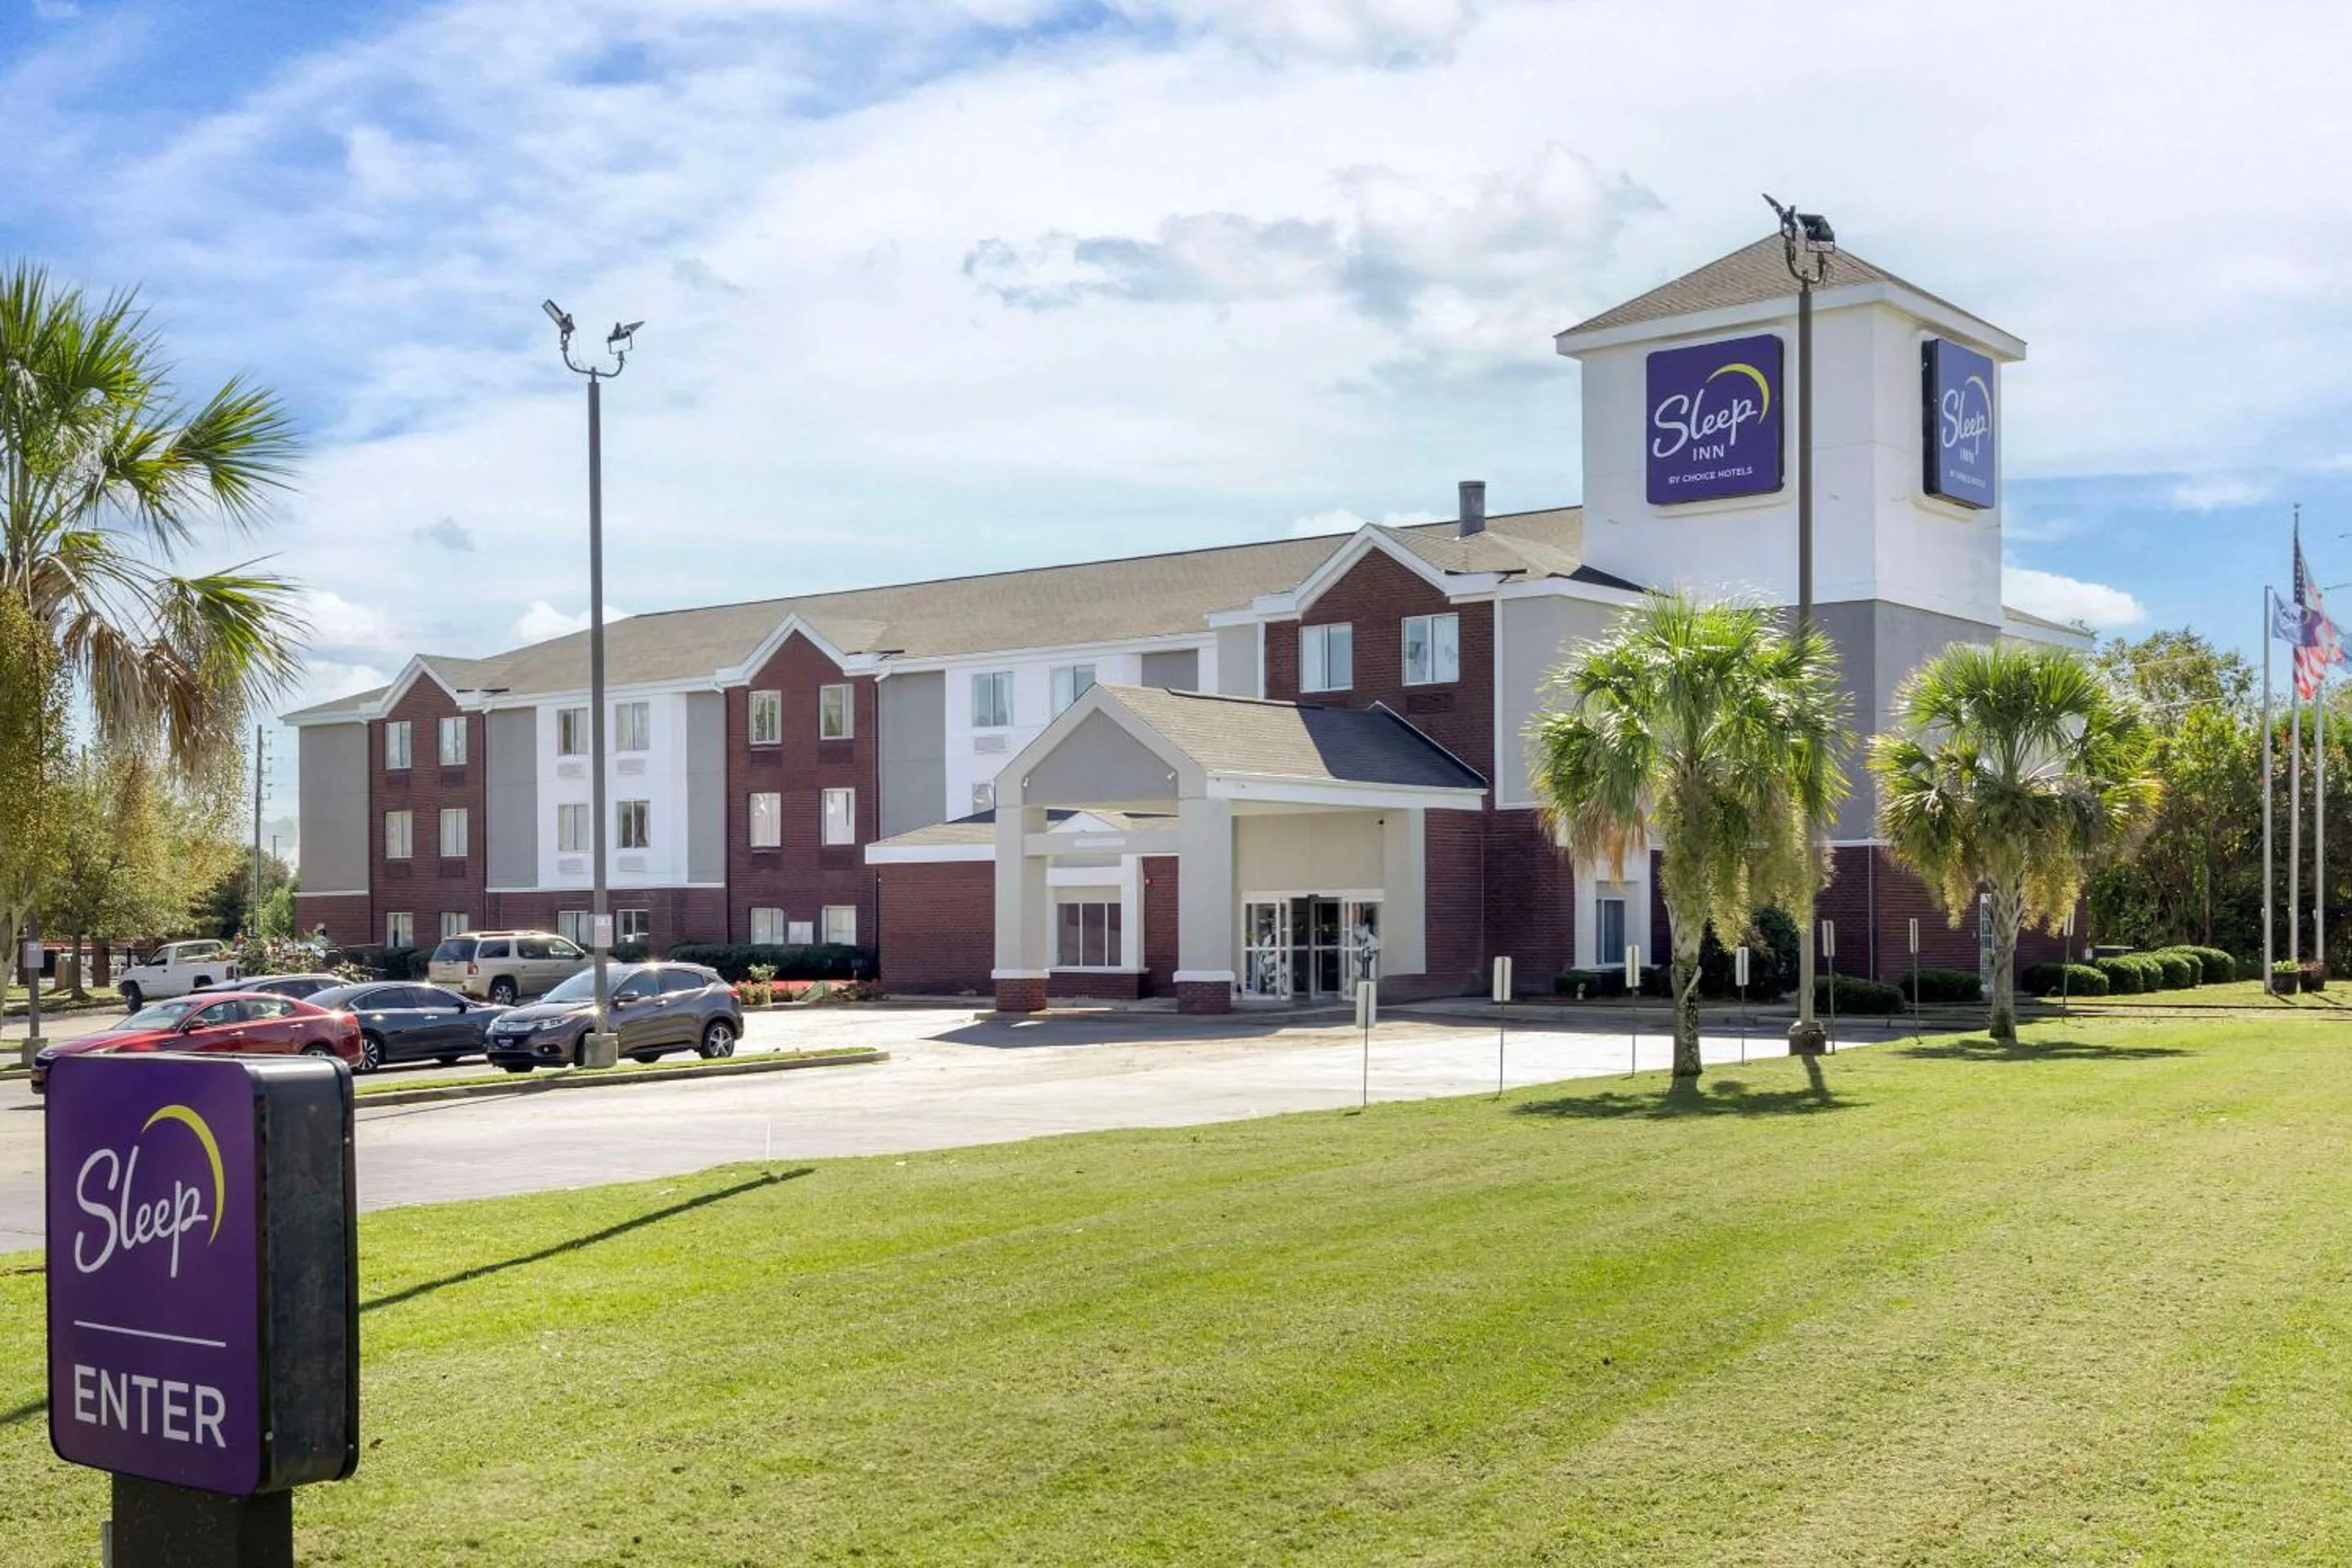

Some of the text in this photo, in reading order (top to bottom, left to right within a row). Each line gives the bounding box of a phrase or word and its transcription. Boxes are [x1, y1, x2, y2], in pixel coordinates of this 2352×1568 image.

[1652, 388, 1758, 458] Sleep
[1692, 443, 1725, 461] INN
[1942, 388, 1988, 456] Sleep
[1959, 447, 1975, 465] INN
[1668, 466, 1753, 484] BY CHOICE HOTELS
[74, 1145, 208, 1279] Sleep
[74, 1363, 226, 1449] ENTER
